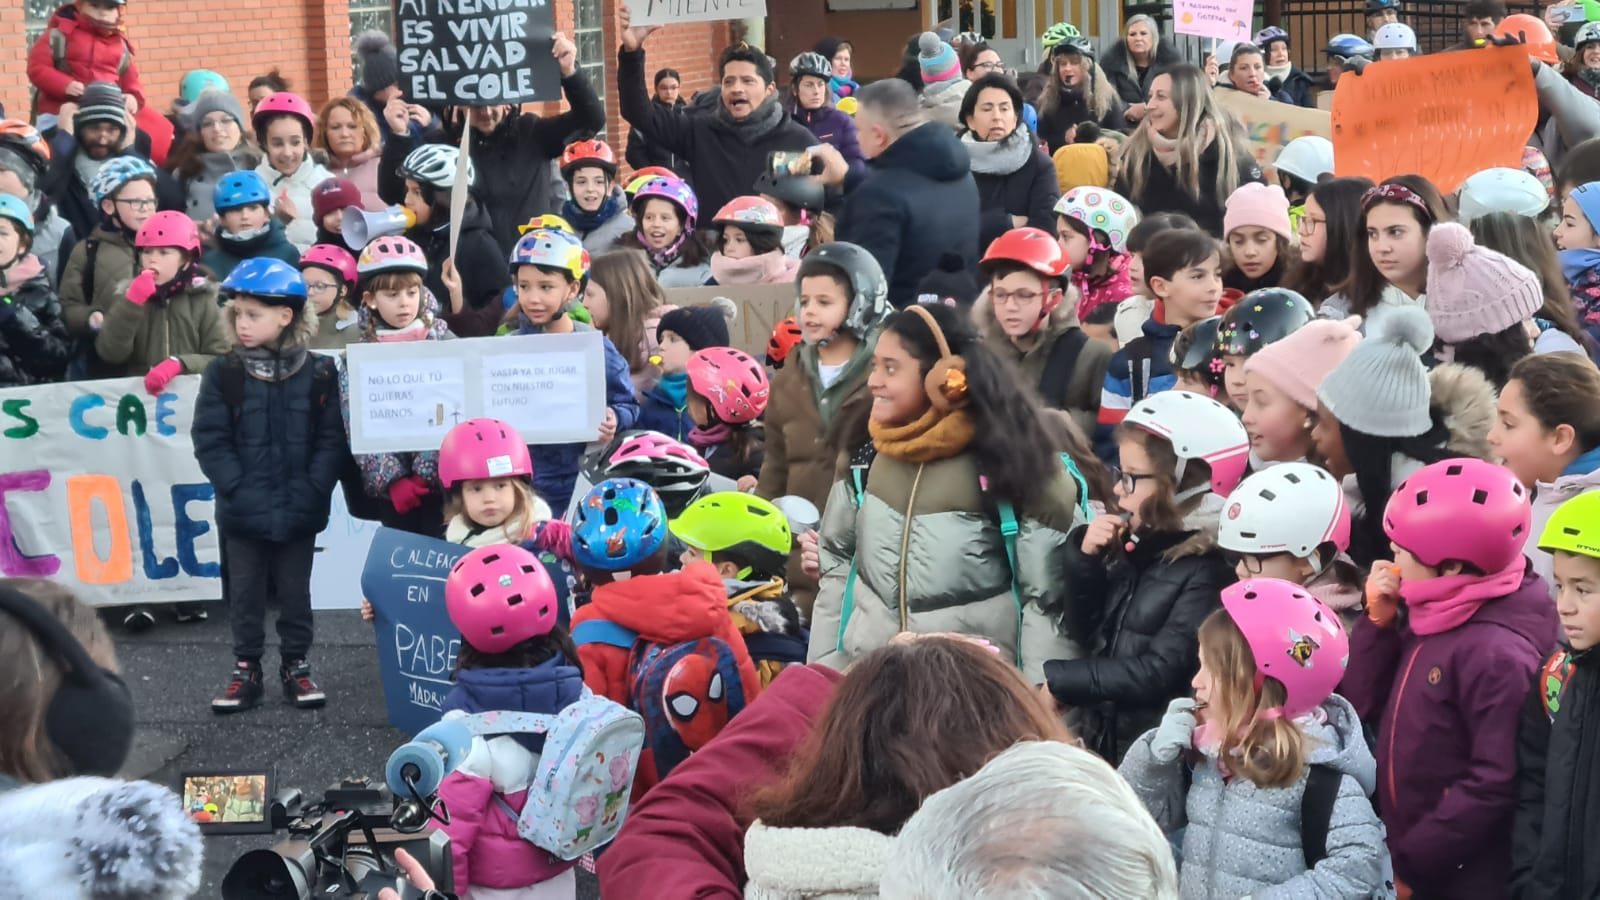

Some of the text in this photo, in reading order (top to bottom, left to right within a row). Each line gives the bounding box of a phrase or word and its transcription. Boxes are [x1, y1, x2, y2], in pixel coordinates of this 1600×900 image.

[398, 0, 546, 16] AREN
[647, 0, 753, 17] MIEN
[402, 12, 527, 45] ES VIVIR
[399, 41, 526, 73] SALVAD
[411, 68, 534, 100] EL COLE
[368, 375, 384, 385] NO
[386, 374, 400, 385] LO
[402, 373, 424, 385] QUE
[491, 380, 554, 393] CON NUESTRO
[368, 390, 414, 402] QUIERAS
[69, 393, 178, 440] CAE
[369, 408, 413, 420] DARNOS
[0, 469, 222, 585] COLE
[407, 585, 429, 603] EN
[395, 623, 461, 675] PABE
